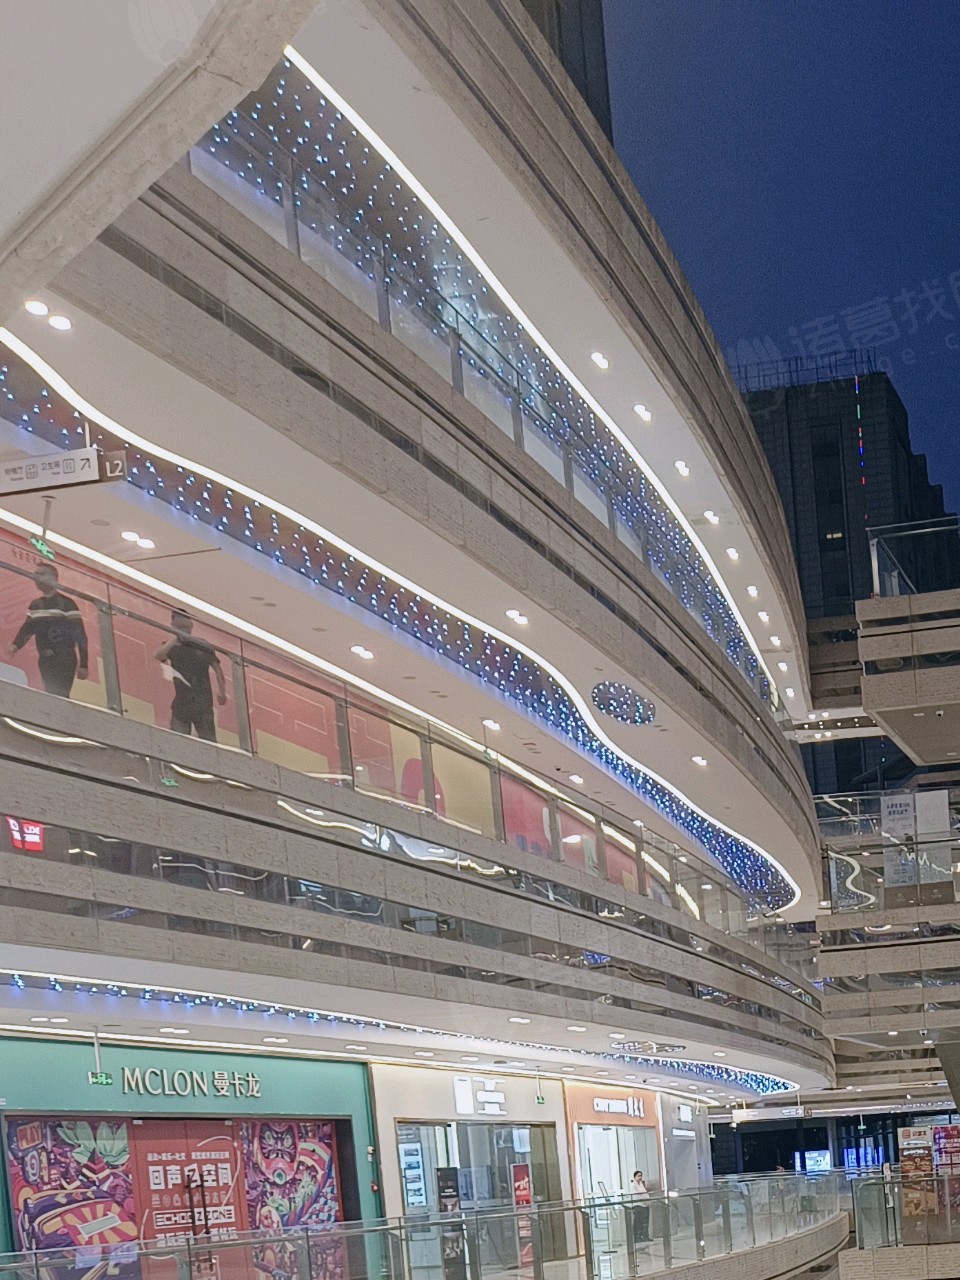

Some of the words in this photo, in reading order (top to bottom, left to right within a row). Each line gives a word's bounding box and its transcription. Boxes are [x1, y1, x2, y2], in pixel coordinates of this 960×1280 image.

[105, 460, 124, 477] L2
[122, 1066, 208, 1096] MCLON
[213, 1070, 262, 1098] 曼卡龙
